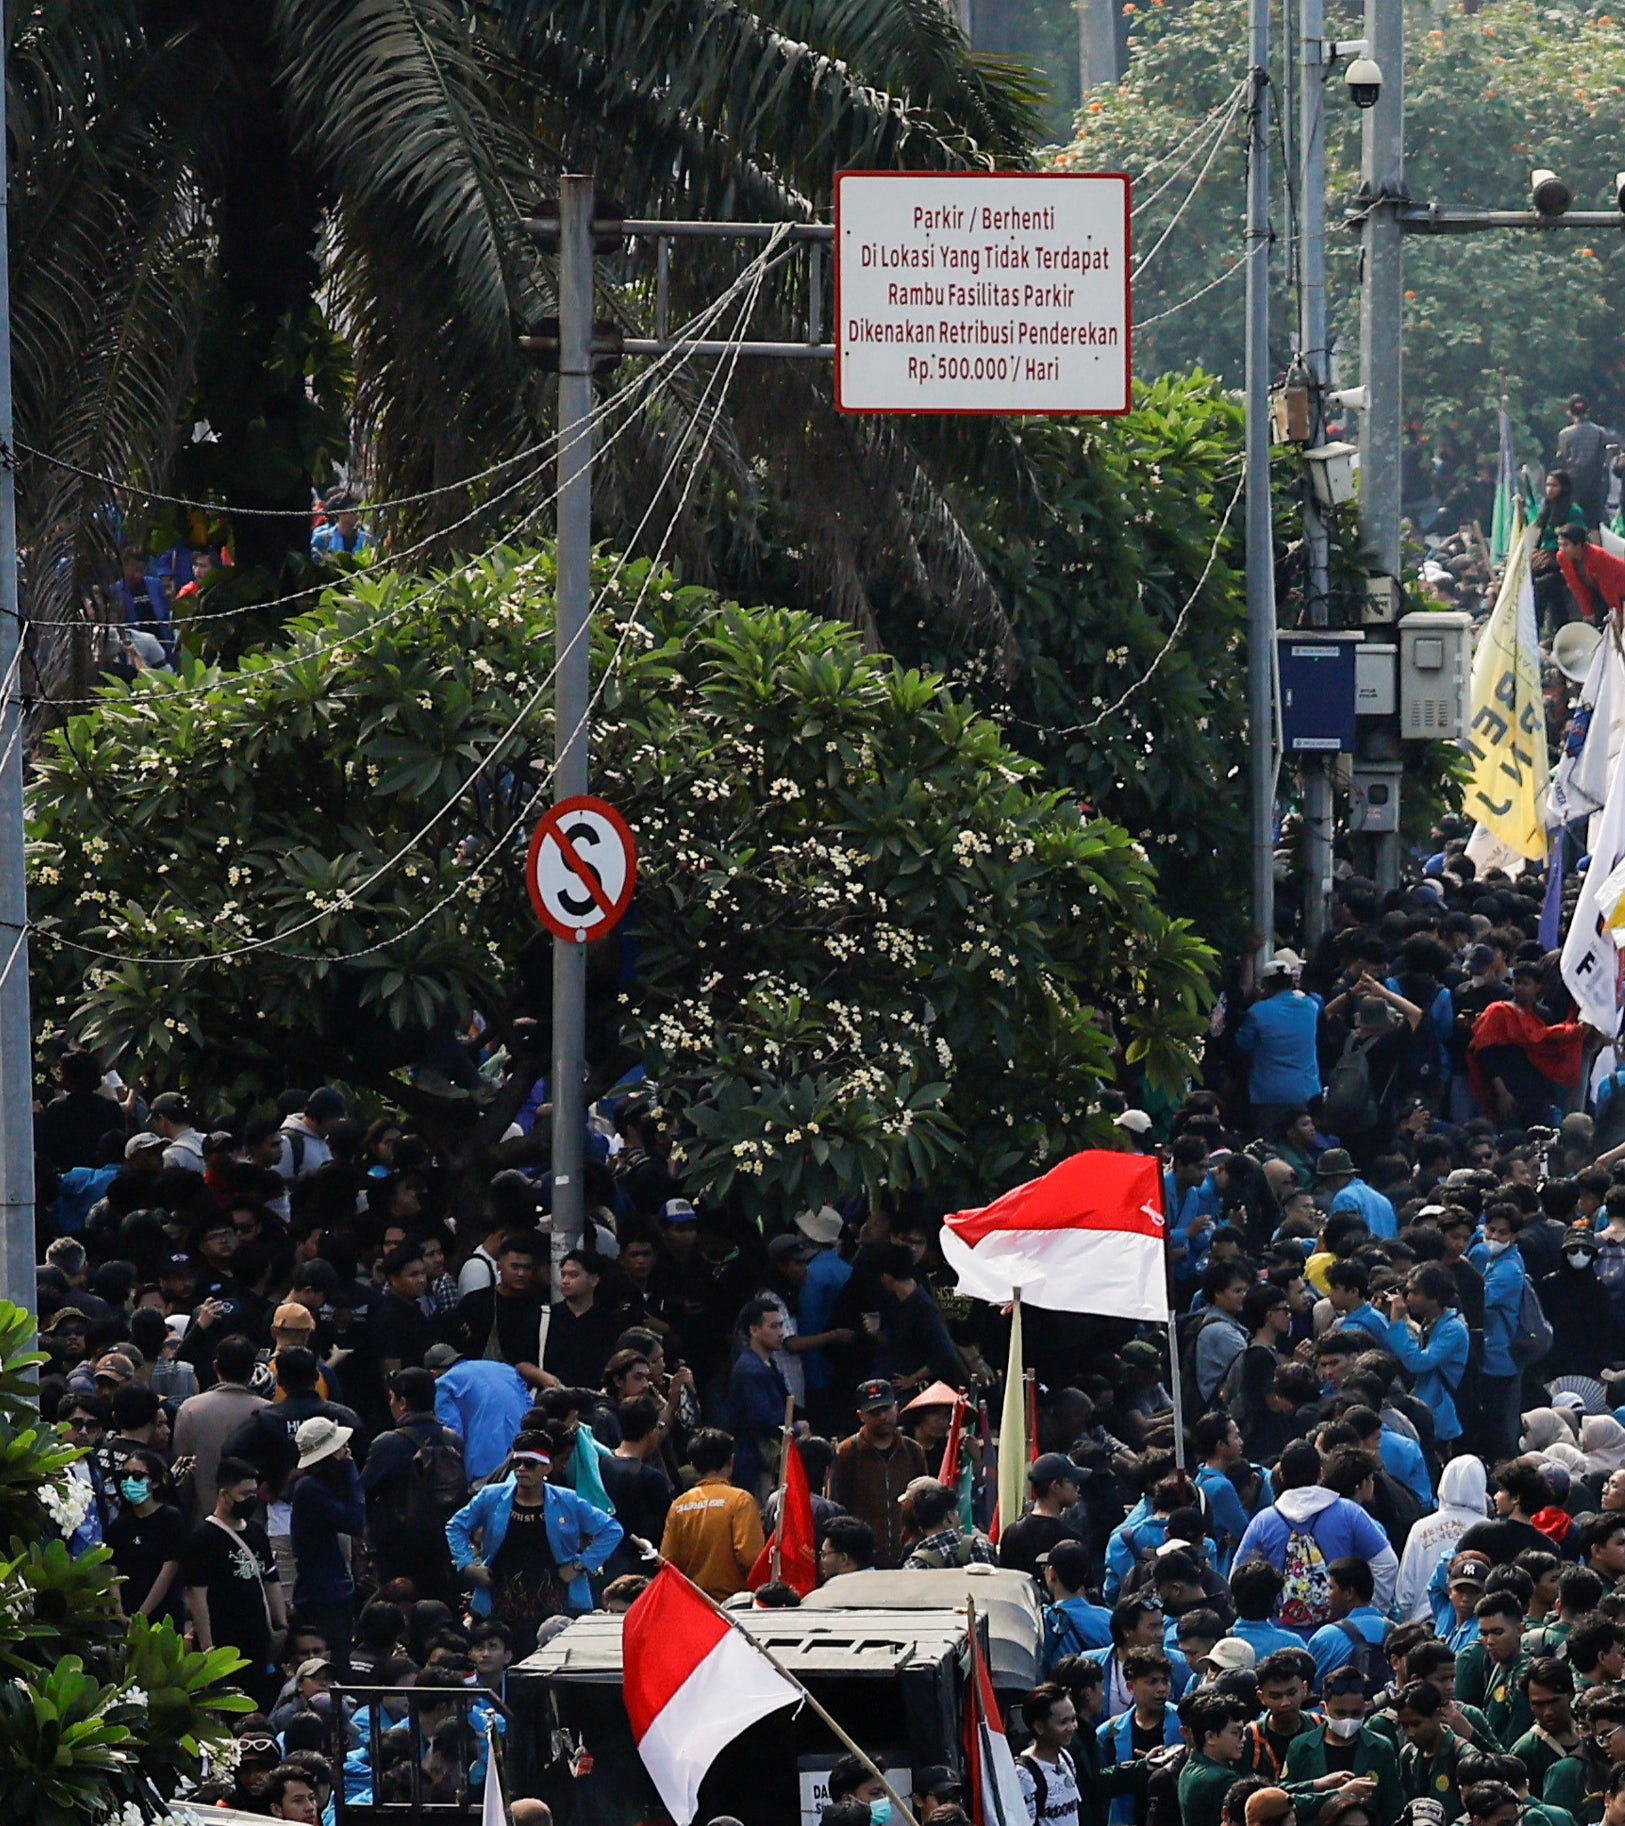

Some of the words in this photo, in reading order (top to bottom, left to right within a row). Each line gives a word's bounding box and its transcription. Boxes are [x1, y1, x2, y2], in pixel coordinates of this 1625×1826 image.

[914, 206, 964, 229] Parkir
[982, 206, 1054, 229] Berhenti
[861, 246, 877, 267] Di
[881, 246, 934, 267] Lokasi
[940, 246, 980, 275] Yang
[984, 246, 1030, 269] Tidak
[1036, 247, 1109, 274] Terdapat
[888, 283, 944, 306] Rambu
[949, 283, 1019, 307] Fasilitas
[1024, 284, 1074, 308] Parkir
[848, 318, 935, 343] Dikenakan
[939, 320, 1014, 344] Retribusi
[1019, 321, 1118, 346] Penderekan
[907, 357, 934, 384] Rp.
[938, 357, 1008, 380] 500.000
[1026, 358, 1059, 381] Hari
